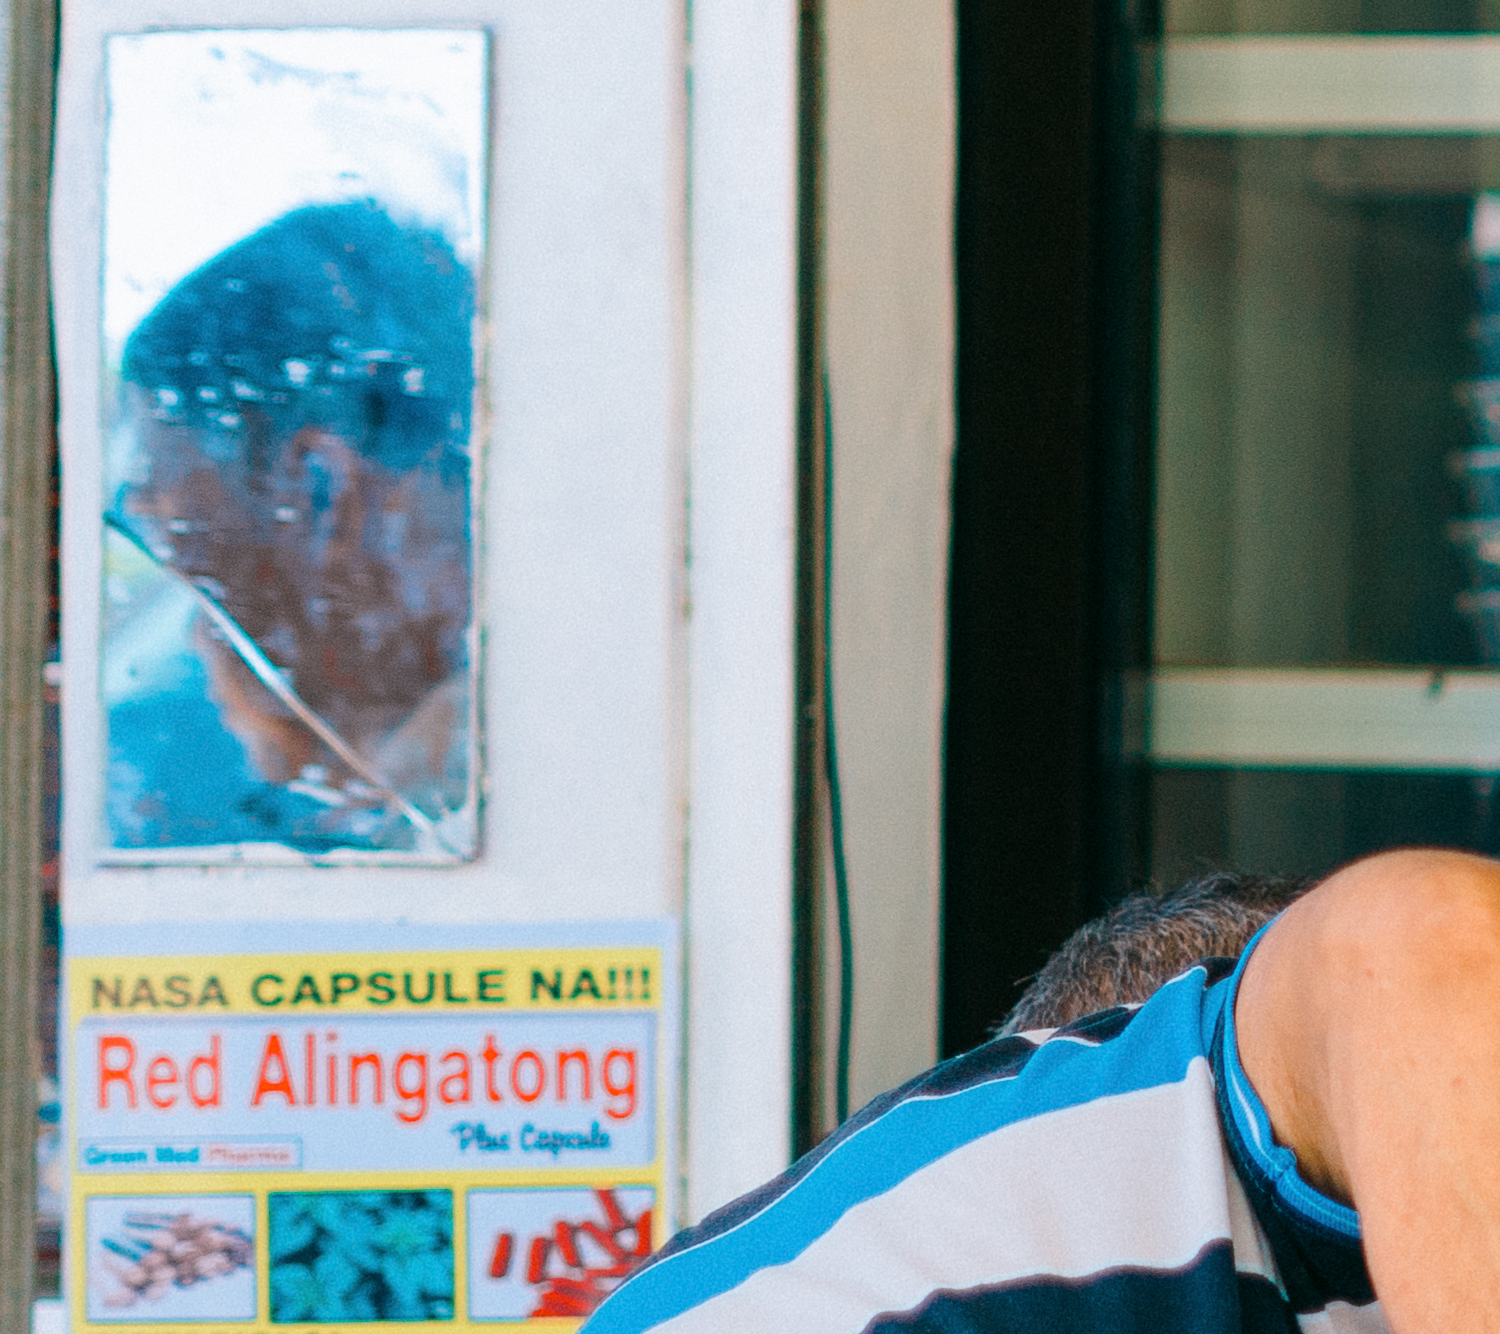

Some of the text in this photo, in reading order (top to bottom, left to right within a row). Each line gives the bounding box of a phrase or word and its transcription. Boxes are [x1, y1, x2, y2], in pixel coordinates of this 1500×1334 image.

[92, 967, 652, 1010] NASA CAPSULE NA!!!
[97, 1029, 638, 1123] Red Alingatong
